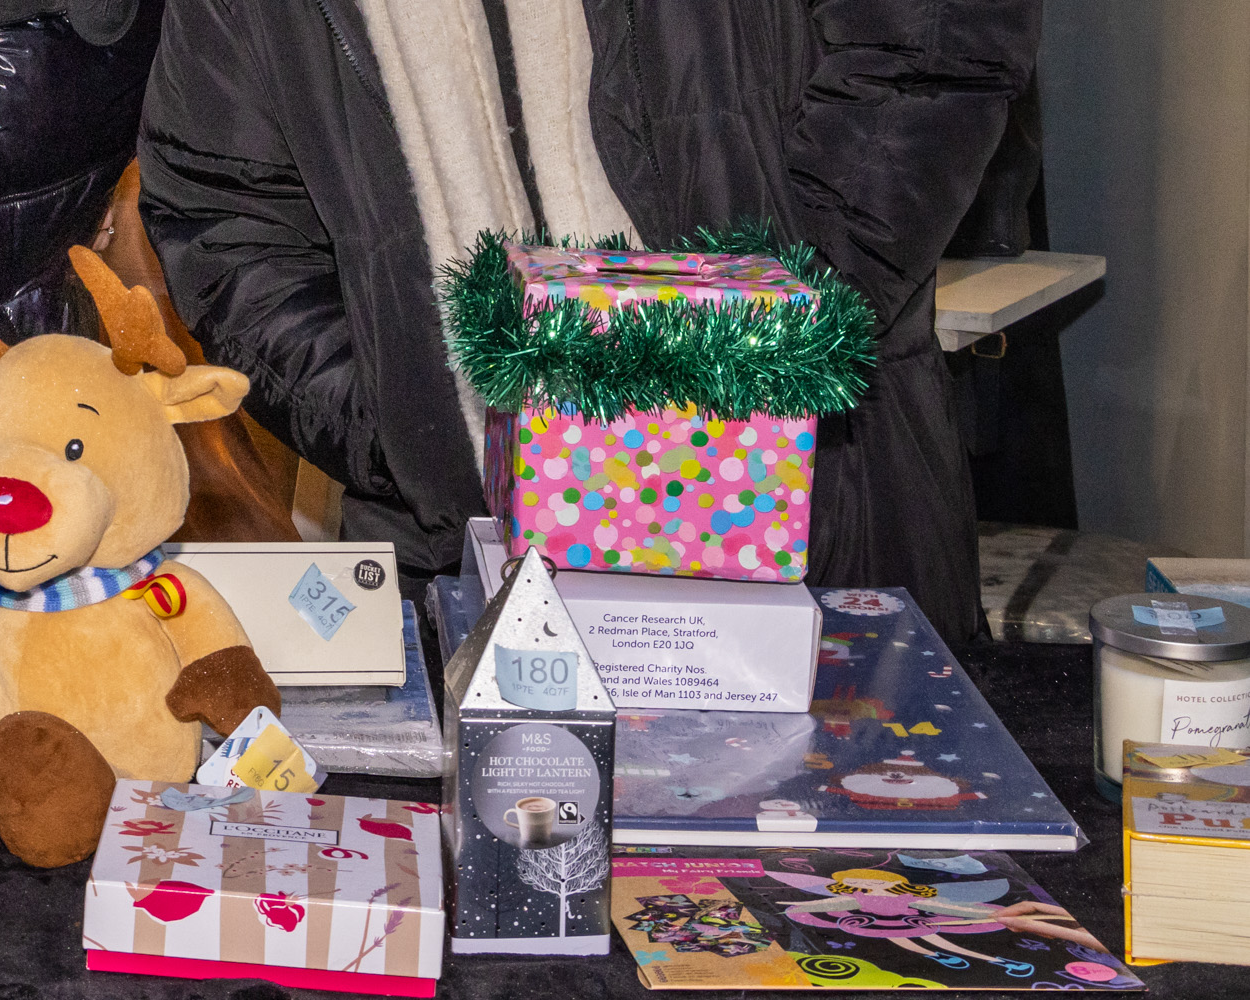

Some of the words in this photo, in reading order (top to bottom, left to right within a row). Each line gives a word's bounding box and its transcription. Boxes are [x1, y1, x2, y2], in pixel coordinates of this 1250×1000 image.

[360, 564, 382, 574] BUCKET
[358, 570, 381, 582] LIST
[307, 580, 350, 624] 315
[842, 596, 883, 607] 24
[602, 613, 638, 624] Cancer
[641, 614, 686, 625] Research
[688, 616, 706, 626] UK,
[588, 626, 596, 635] 2
[597, 626, 639, 636] Redman
[641, 627, 670, 638] Place,
[673, 628, 719, 639] Stratford,
[612, 638, 650, 649] London
[653, 640, 672, 650] E20
[674, 640, 695, 650] 1JQ
[511, 656, 569, 685] 180
[593, 662, 644, 674] Registered
[647, 664, 683, 676] Charity
[685, 664, 708, 674] Nos.
[622, 676, 641, 685] and
[643, 676, 673, 686] Wales
[675, 678, 720, 688] 1089464
[512, 683, 536, 695] 1P7E
[542, 687, 570, 696] 4Q7F
[622, 688, 639, 698] Isle
[641, 688, 652, 698] of
[654, 689, 676, 699] Man
[678, 690, 702, 700] 1103
[704, 690, 722, 700] and
[724, 691, 758, 702] Jersey
[759, 692, 778, 702] 247
[1176, 695, 1207, 703] HOTEL
[522, 732, 552, 745] M&S
[489, 756, 514, 766] HOT
[515, 757, 585, 766] CHOCOLATE
[266, 760, 296, 792] 15
[482, 768, 516, 777] LIGHT
[518, 768, 534, 777] UP
[536, 768, 592, 778] LANTERN
